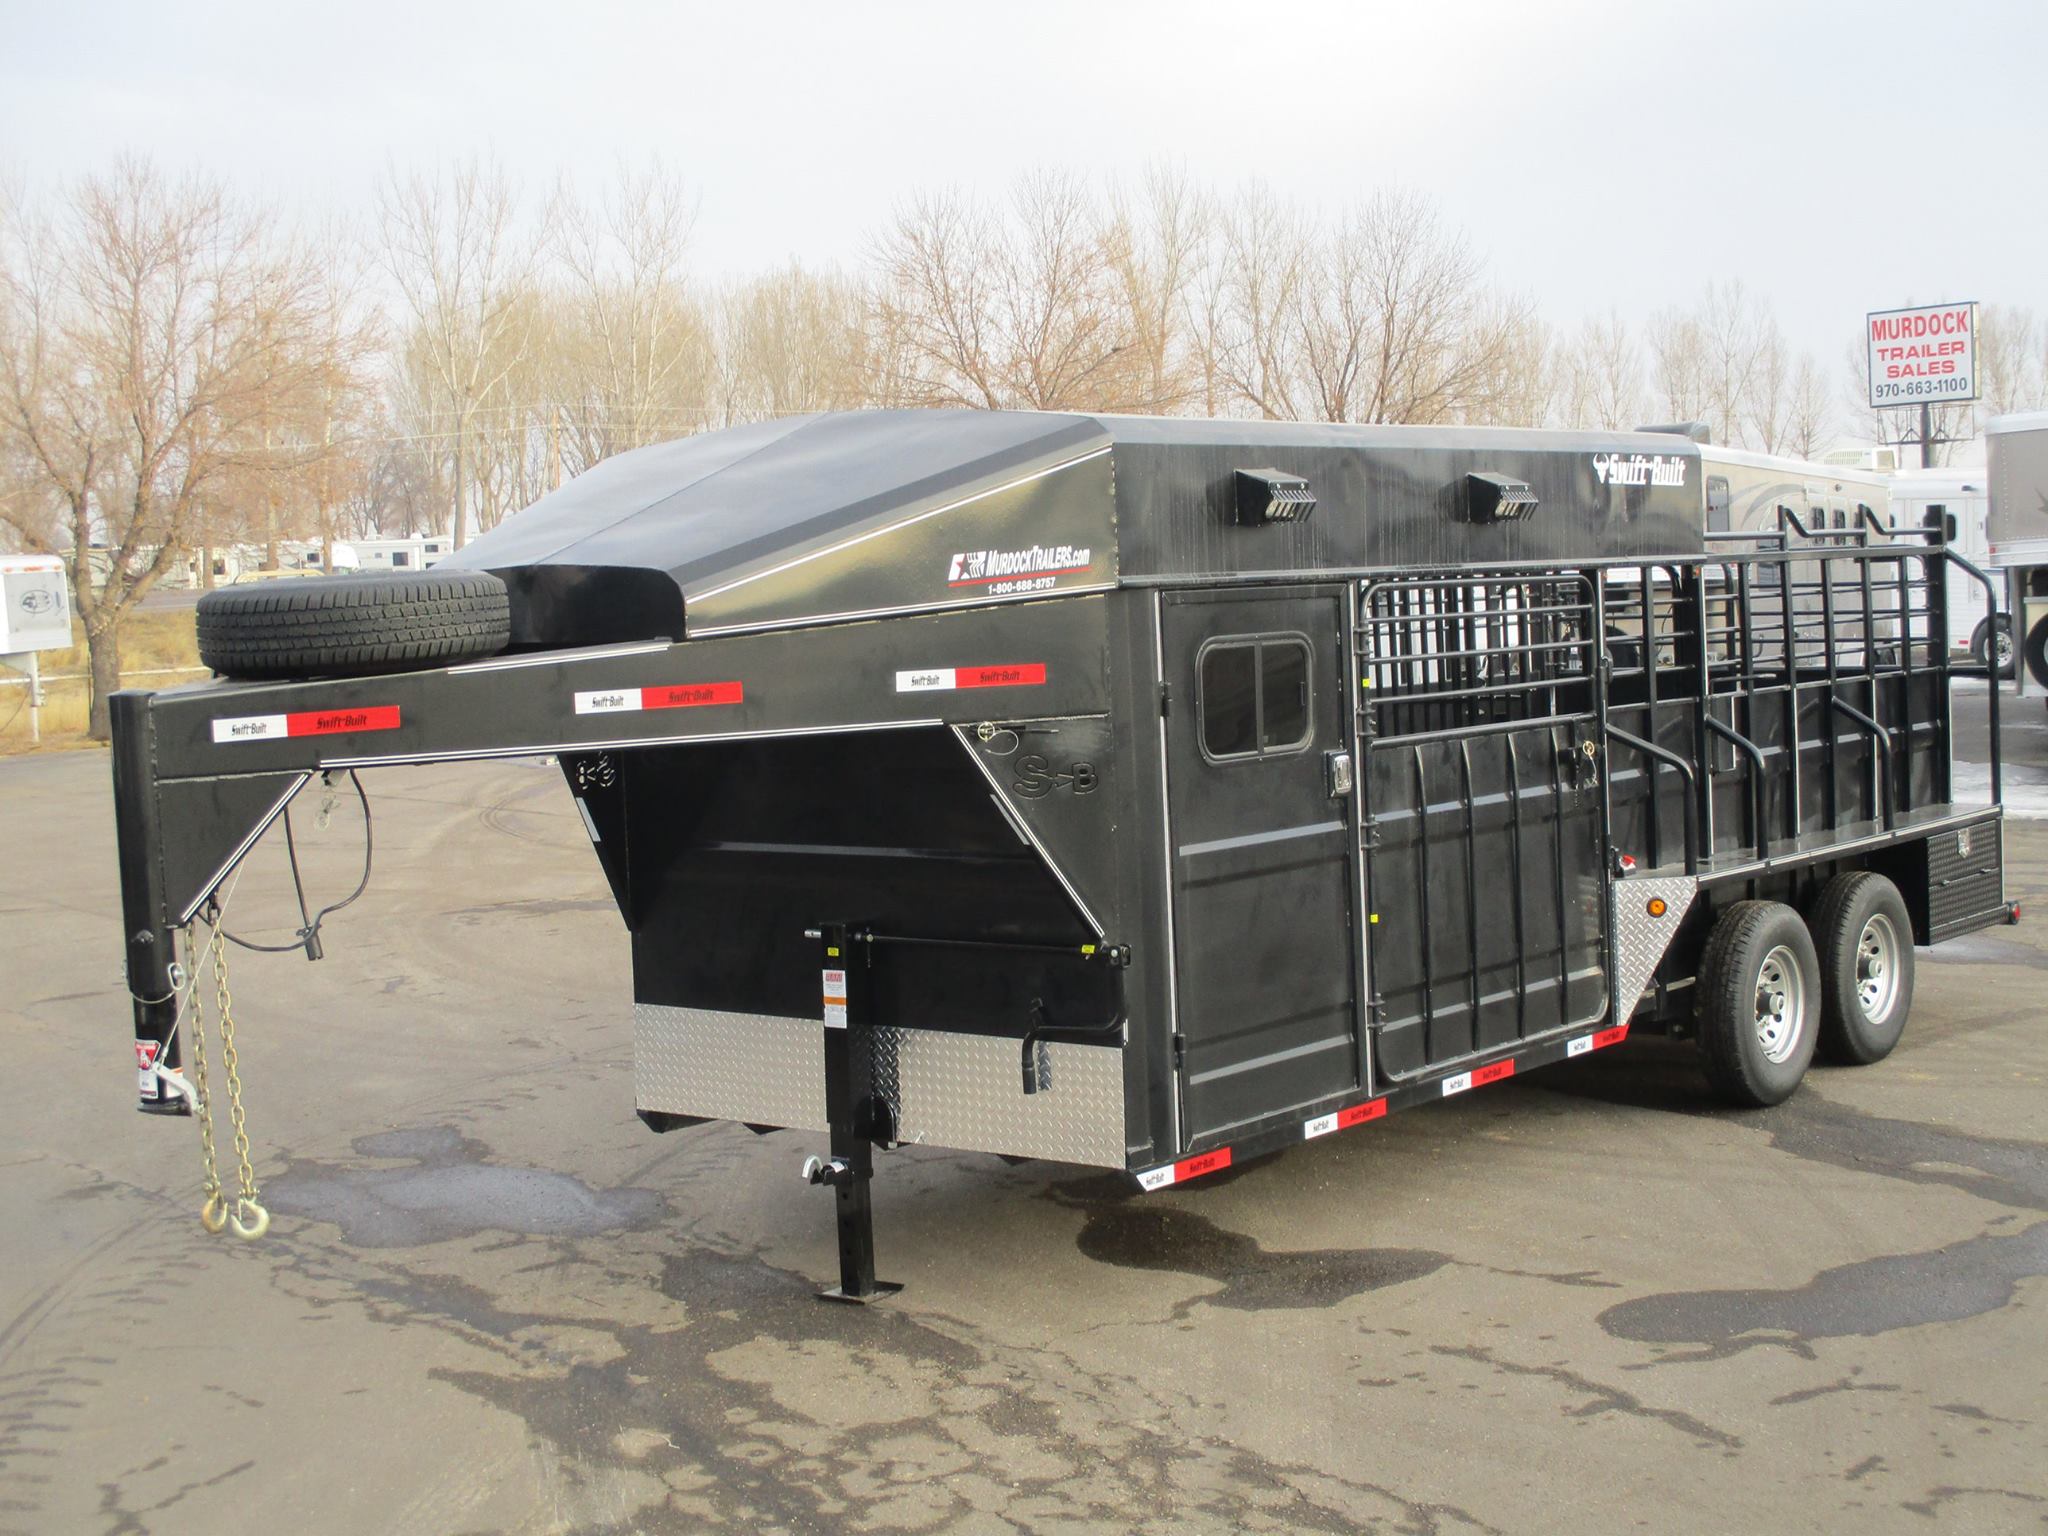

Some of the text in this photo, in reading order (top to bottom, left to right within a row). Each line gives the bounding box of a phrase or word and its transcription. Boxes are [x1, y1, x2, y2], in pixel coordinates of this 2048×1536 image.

[1871, 311, 1969, 342] MURDOCK
[1877, 341, 1965, 361] TRAILER
[1887, 360, 1955, 379] SALES
[1876, 377, 1968, 398] 970-663-1100
